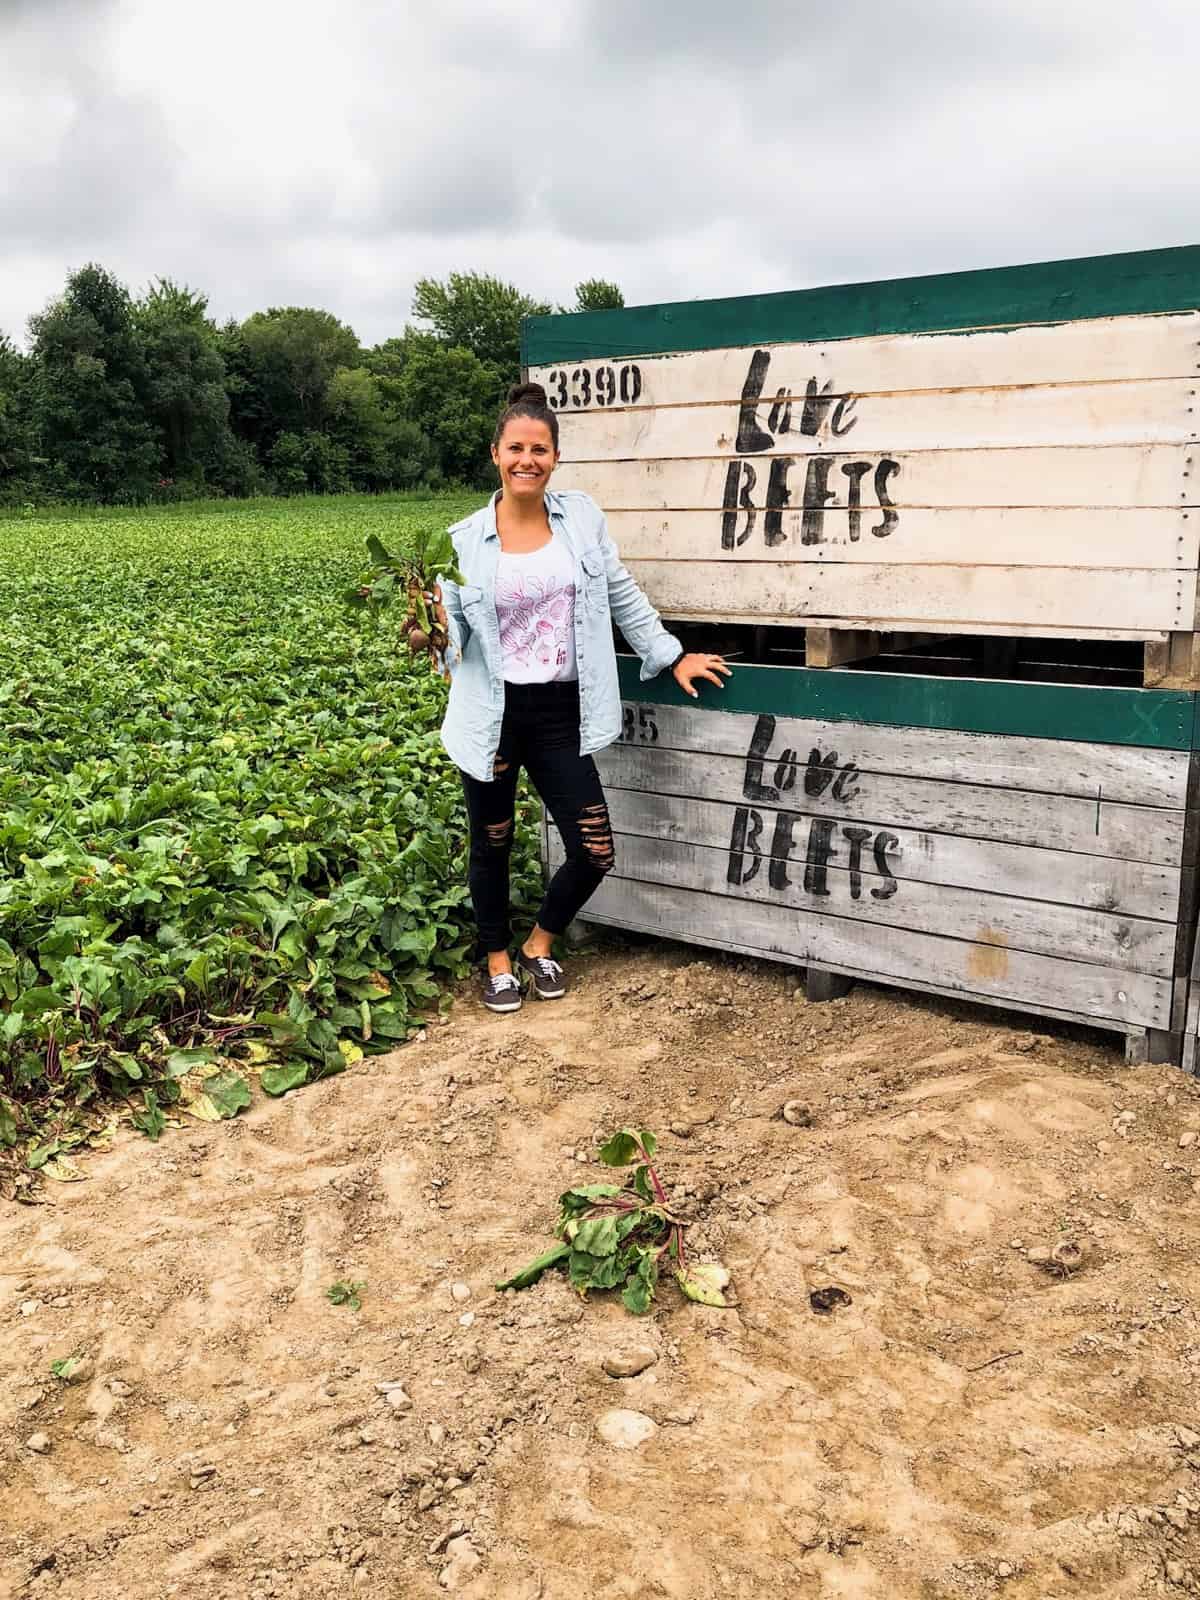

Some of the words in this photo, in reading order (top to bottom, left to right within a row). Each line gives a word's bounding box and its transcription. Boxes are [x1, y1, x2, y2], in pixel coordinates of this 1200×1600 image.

[549, 364, 641, 408] 3390
[721, 457, 900, 551] BEETS
[727, 807, 898, 899] BEETS
